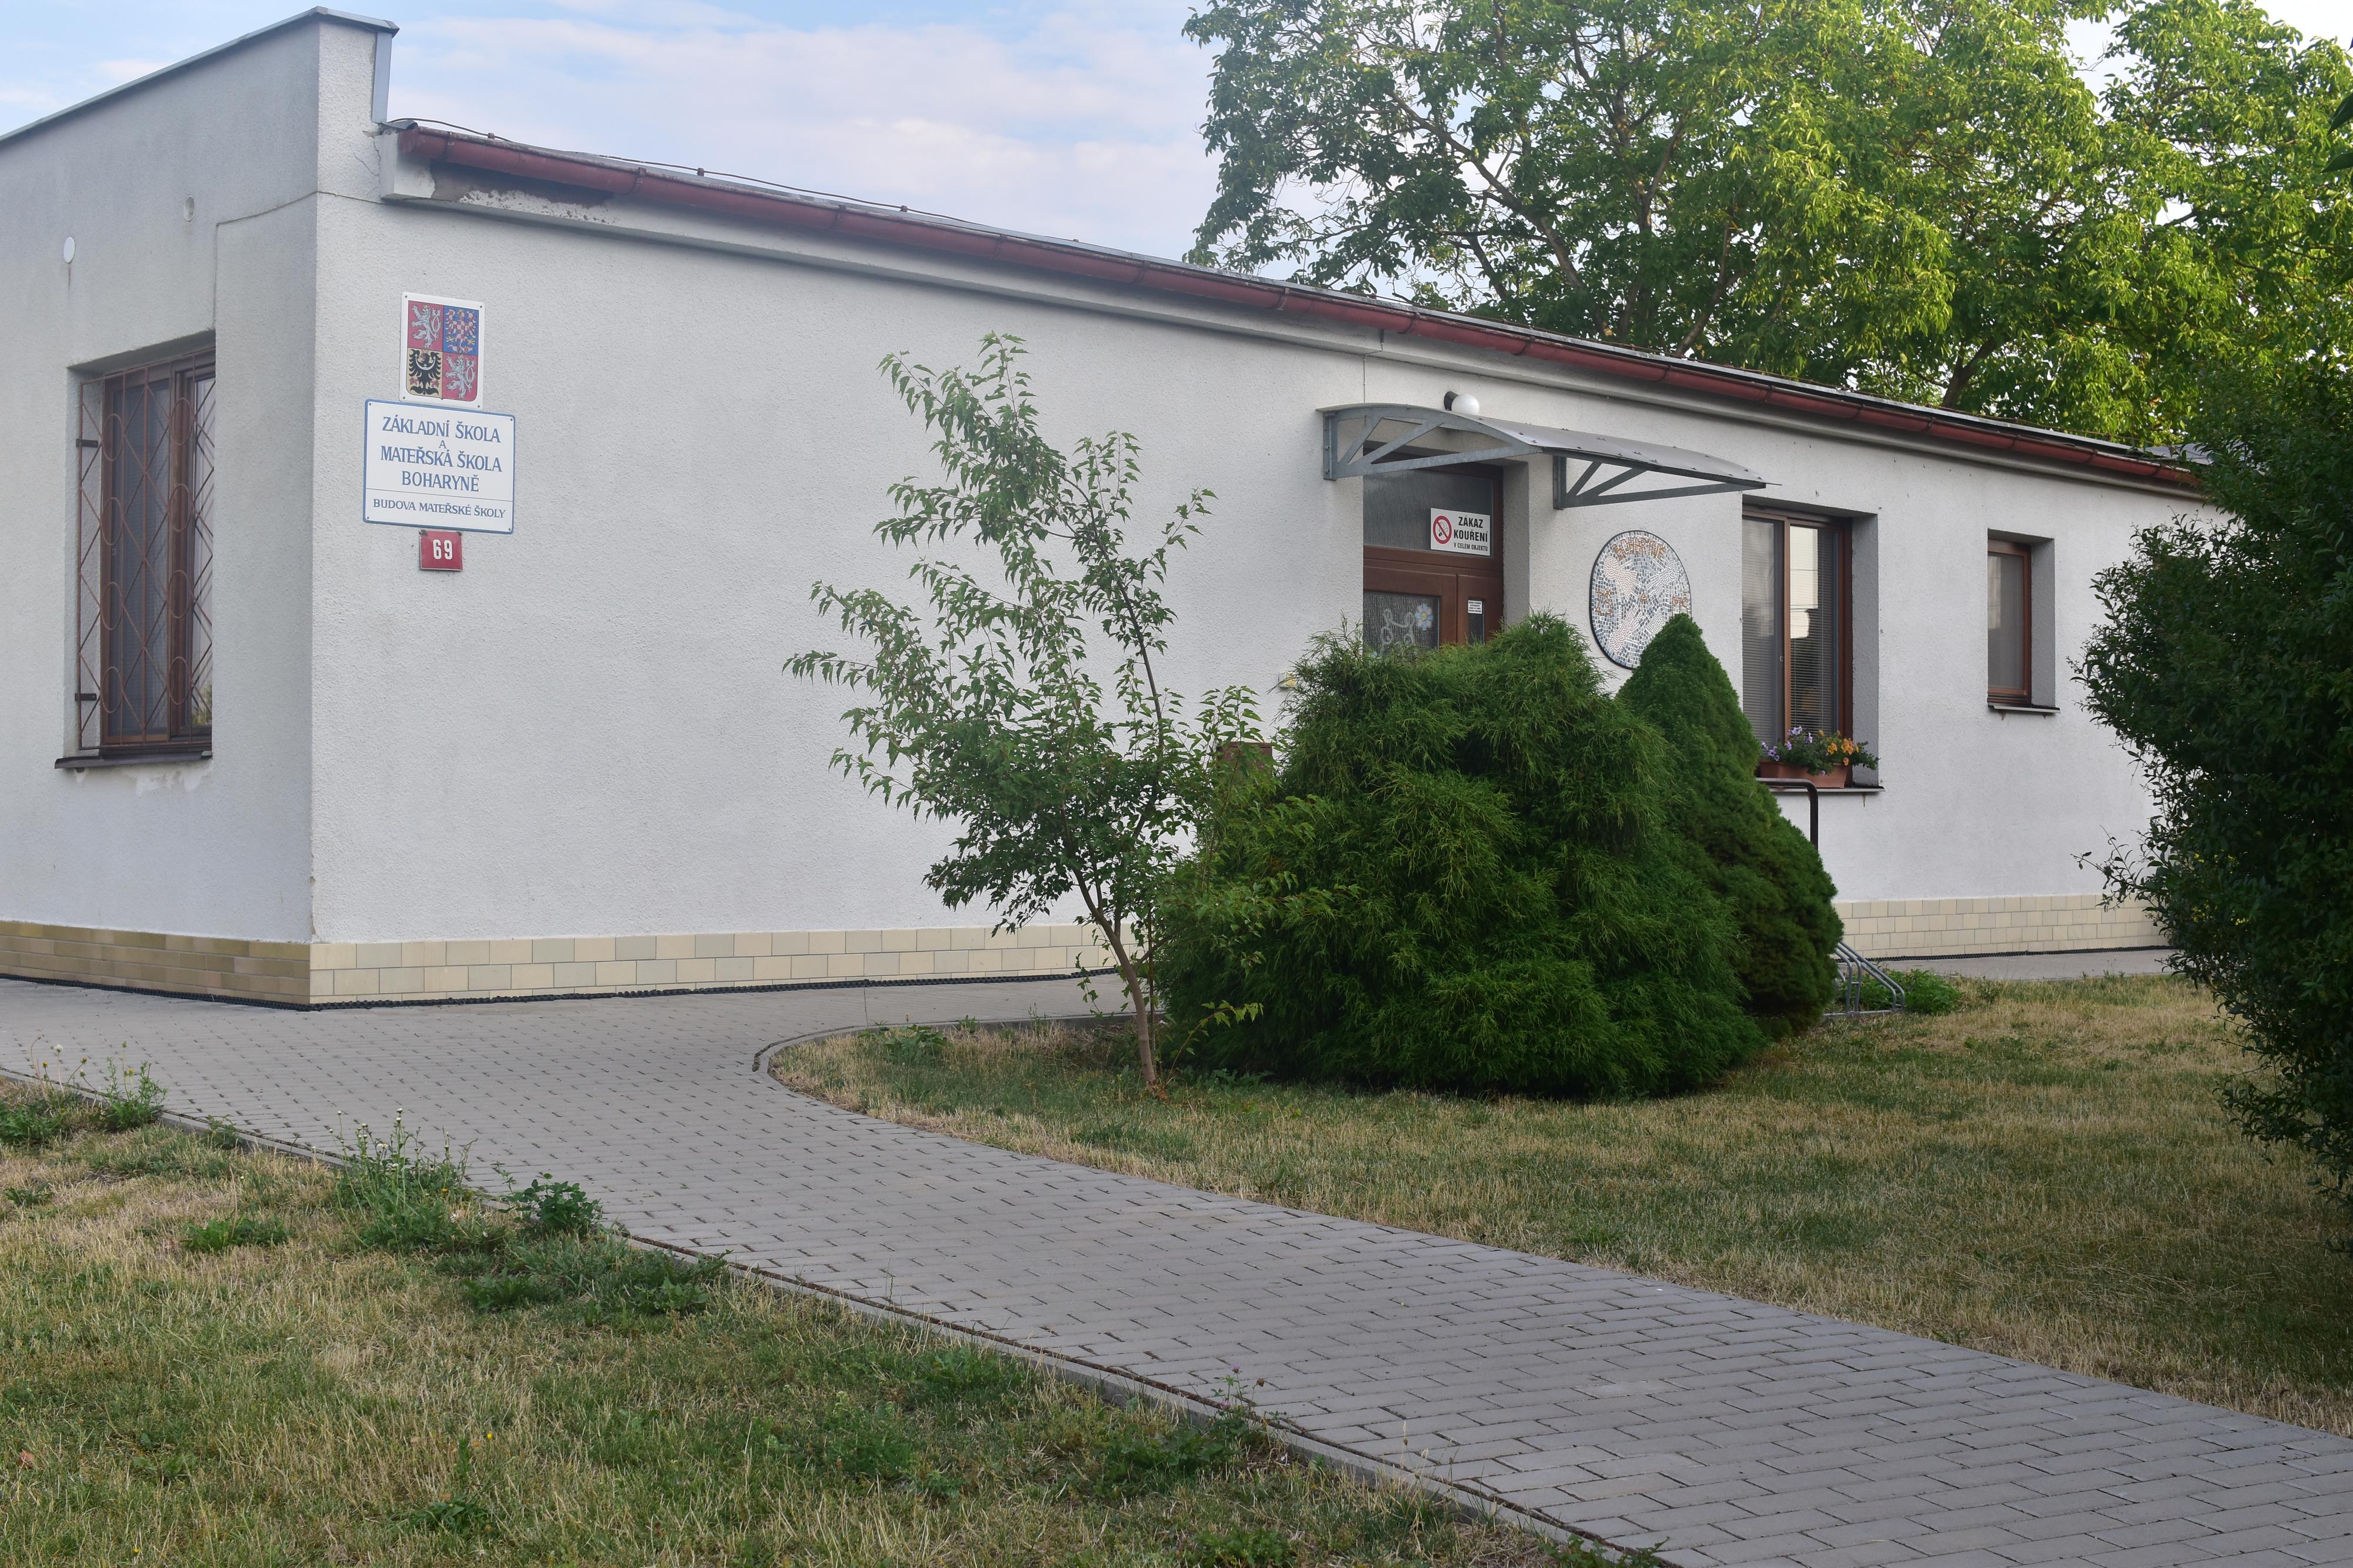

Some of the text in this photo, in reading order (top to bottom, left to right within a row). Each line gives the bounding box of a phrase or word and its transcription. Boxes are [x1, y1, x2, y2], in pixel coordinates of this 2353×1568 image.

[382, 415, 501, 443] ZÁKLADNÍ ŠKOLA
[439, 440, 446, 449] A
[381, 445, 502, 472] MATEŘSKÁ ŠKOLA
[402, 471, 479, 492] BOHARYNĚ
[374, 499, 506, 518] BUDOVA MATEŘSKÉ ŠKOLY
[1458, 515, 1484, 528] ZÁKAZ
[1454, 529, 1488, 542] KOUŘENÍ
[432, 539, 453, 560] 69
